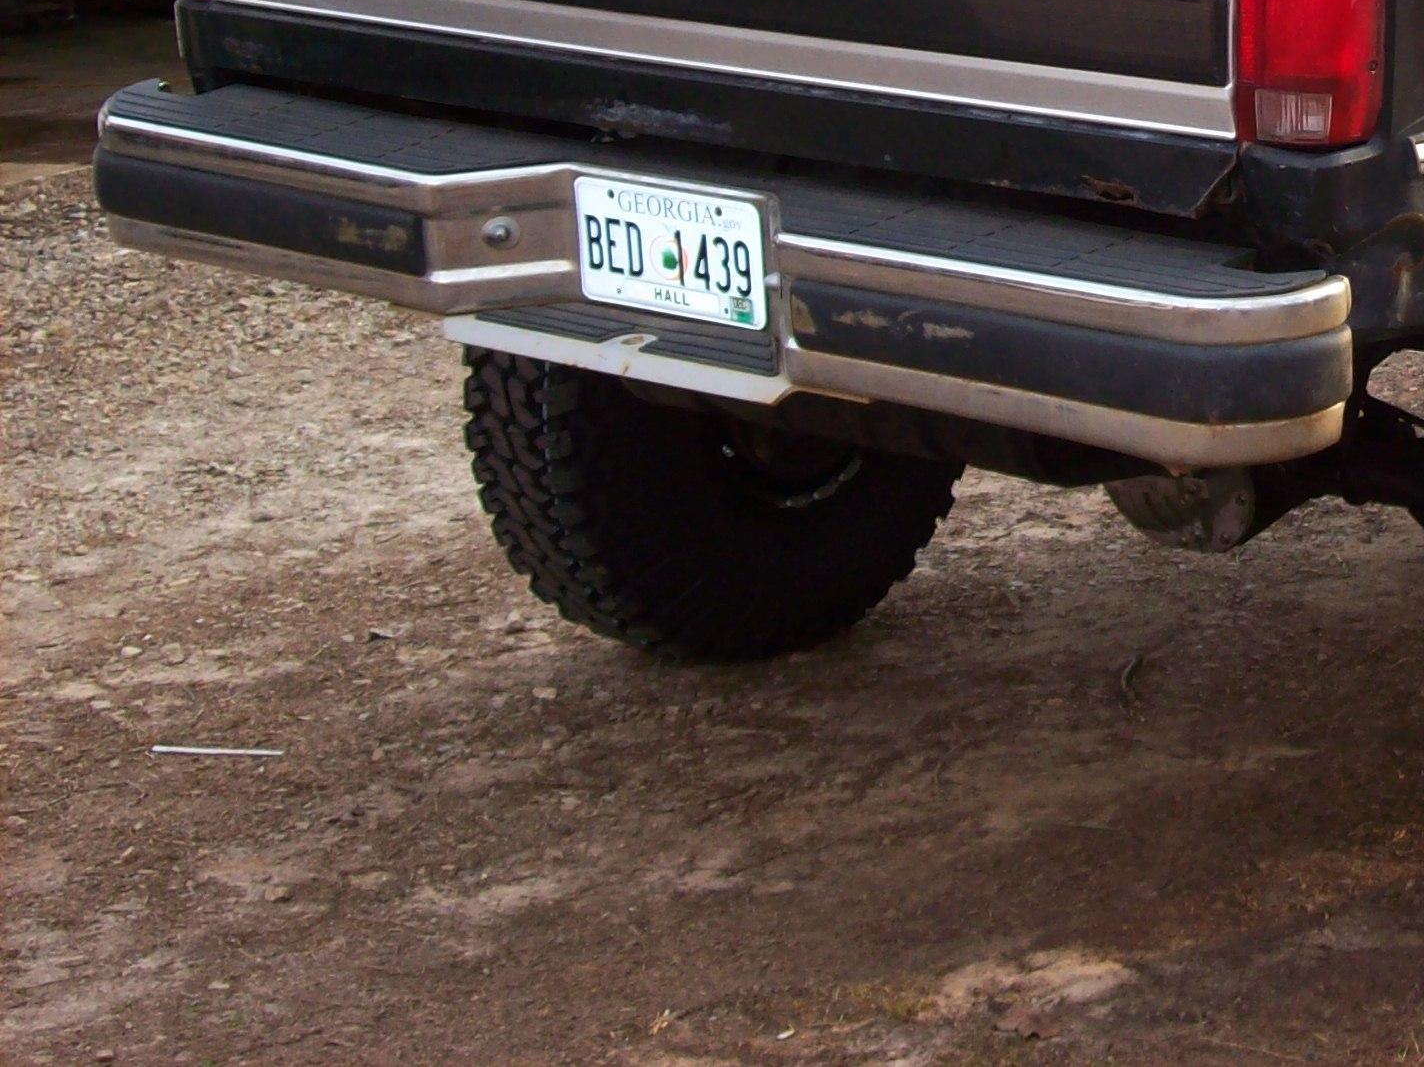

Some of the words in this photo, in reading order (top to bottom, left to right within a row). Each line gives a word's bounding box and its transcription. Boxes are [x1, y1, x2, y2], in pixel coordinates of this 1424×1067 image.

[584, 214, 644, 277] BED
[674, 230, 752, 297] 1439
[654, 288, 691, 306] HALL
